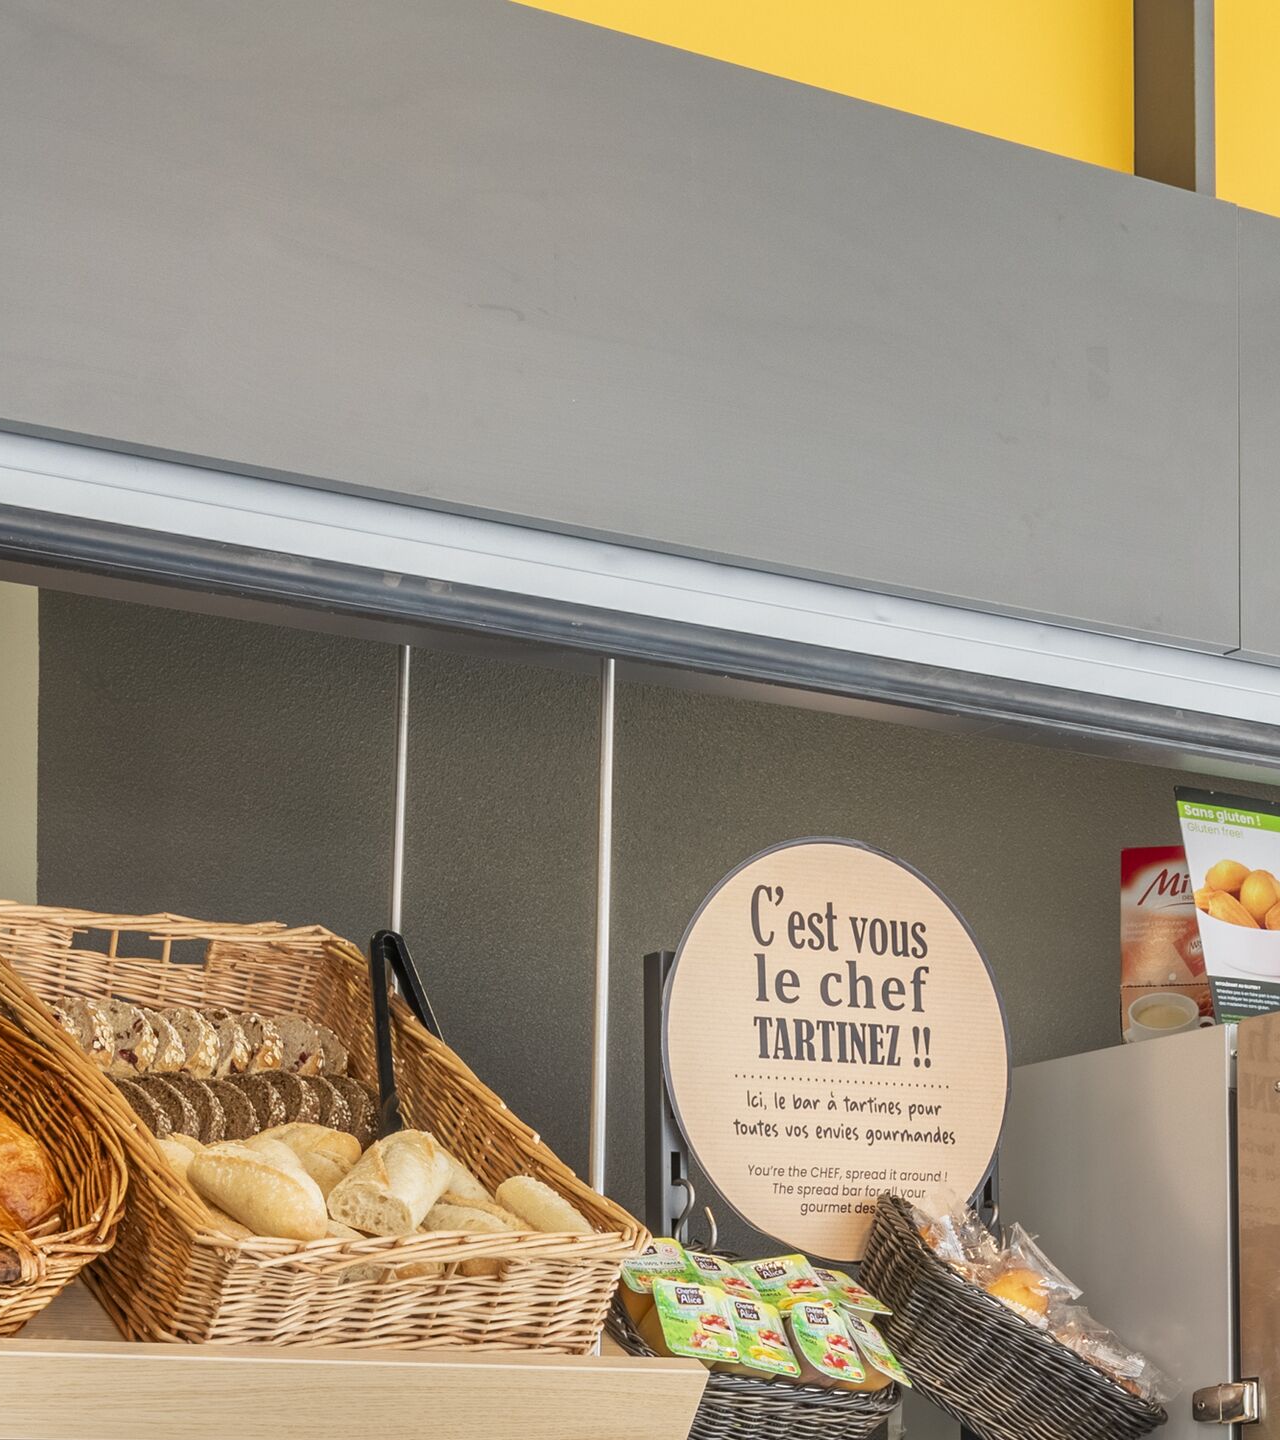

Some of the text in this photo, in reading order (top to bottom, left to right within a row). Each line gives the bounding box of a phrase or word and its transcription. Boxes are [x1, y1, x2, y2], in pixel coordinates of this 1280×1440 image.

[1184, 804, 1262, 826] Sans gluten !
[1187, 822, 1220, 834] Gluten
[751, 884, 928, 959] C'est vous
[754, 953, 929, 1012] le chef
[753, 1016, 932, 1068] TARTINEZ !!
[746, 1090, 942, 1121] Ici, le bar à tartines pour
[733, 1118, 956, 1146] toutes vos envies gourmandes
[748, 1164, 785, 1177] You're
[788, 1165, 807, 1178] the
[810, 1166, 842, 1180] CHEF,
[846, 1168, 886, 1182] spread
[890, 1169, 897, 1180] it
[900, 1170, 942, 1182] around
[772, 1183, 794, 1194] The
[797, 1184, 838, 1199] spread
[842, 1185, 862, 1196] bar
[865, 1186, 880, 1196] for
[900, 1188, 926, 1202] your
[800, 1202, 876, 1216] gourmet des
[680, 1294, 702, 1304] Alice
[740, 1309, 758, 1319] Alice
[809, 1314, 827, 1324] Alice
